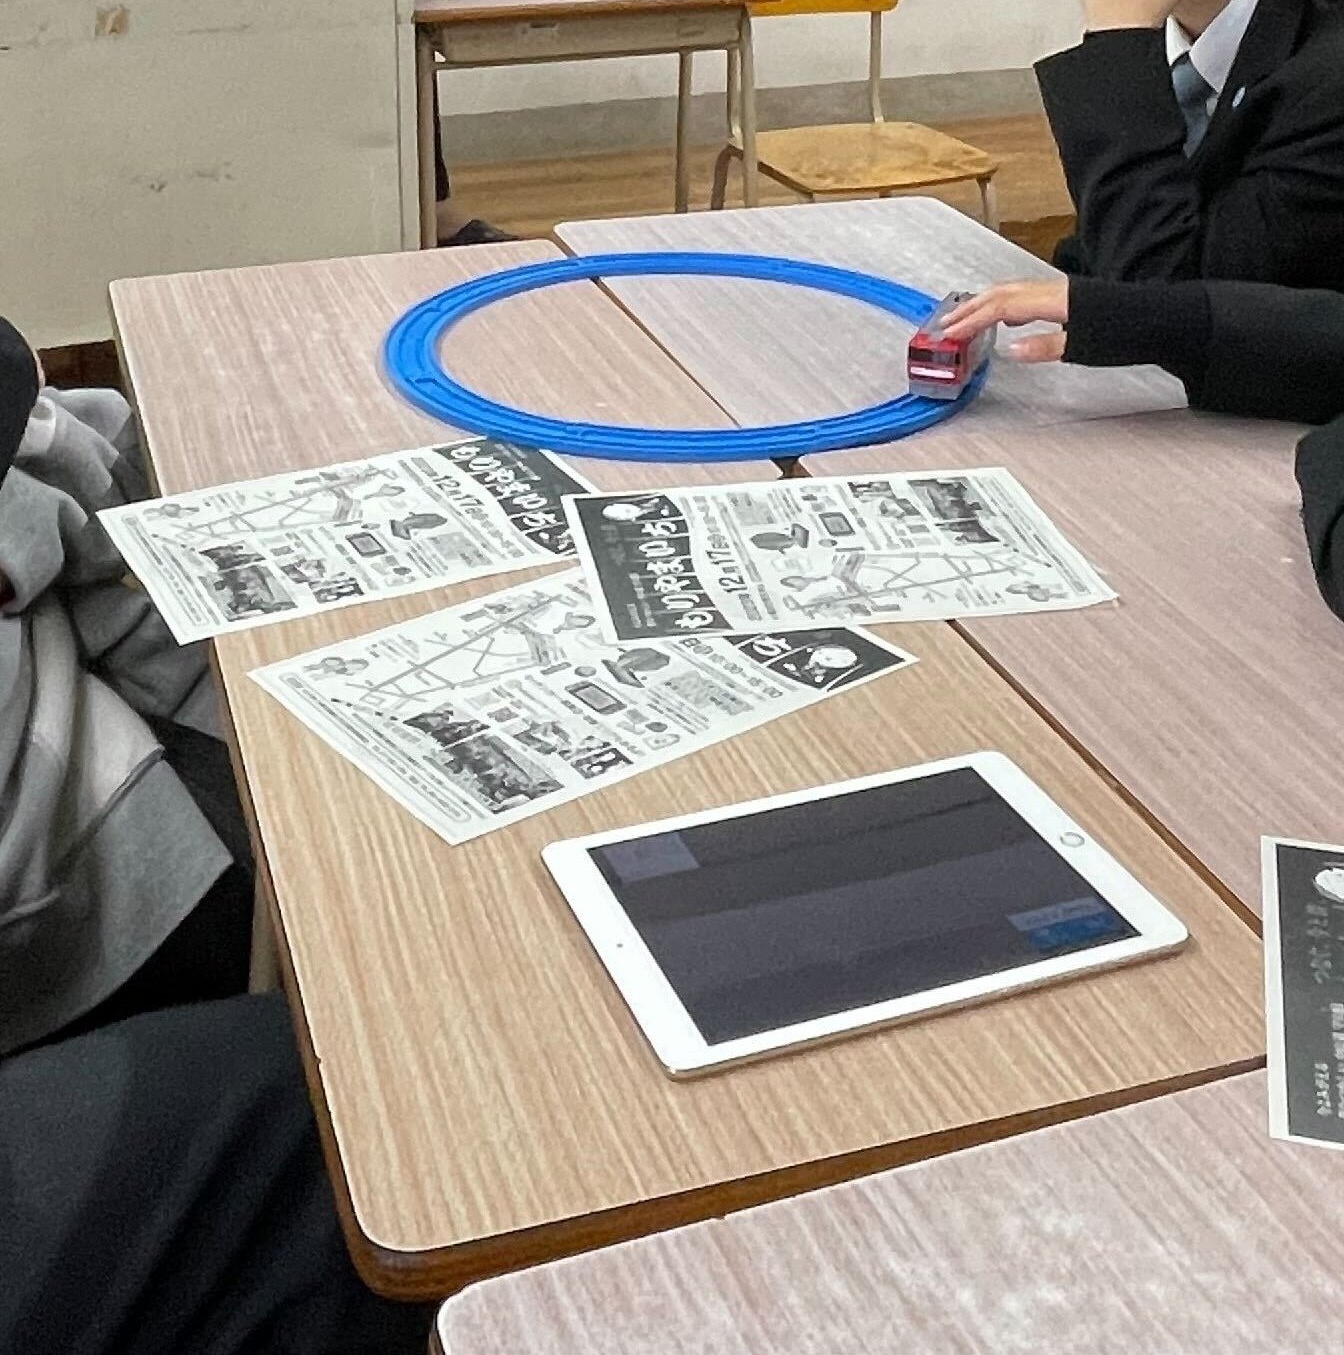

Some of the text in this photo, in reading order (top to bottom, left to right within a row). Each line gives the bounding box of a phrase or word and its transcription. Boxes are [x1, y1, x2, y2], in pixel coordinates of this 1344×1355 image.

[638, 521, 714, 629] もりやまいち
